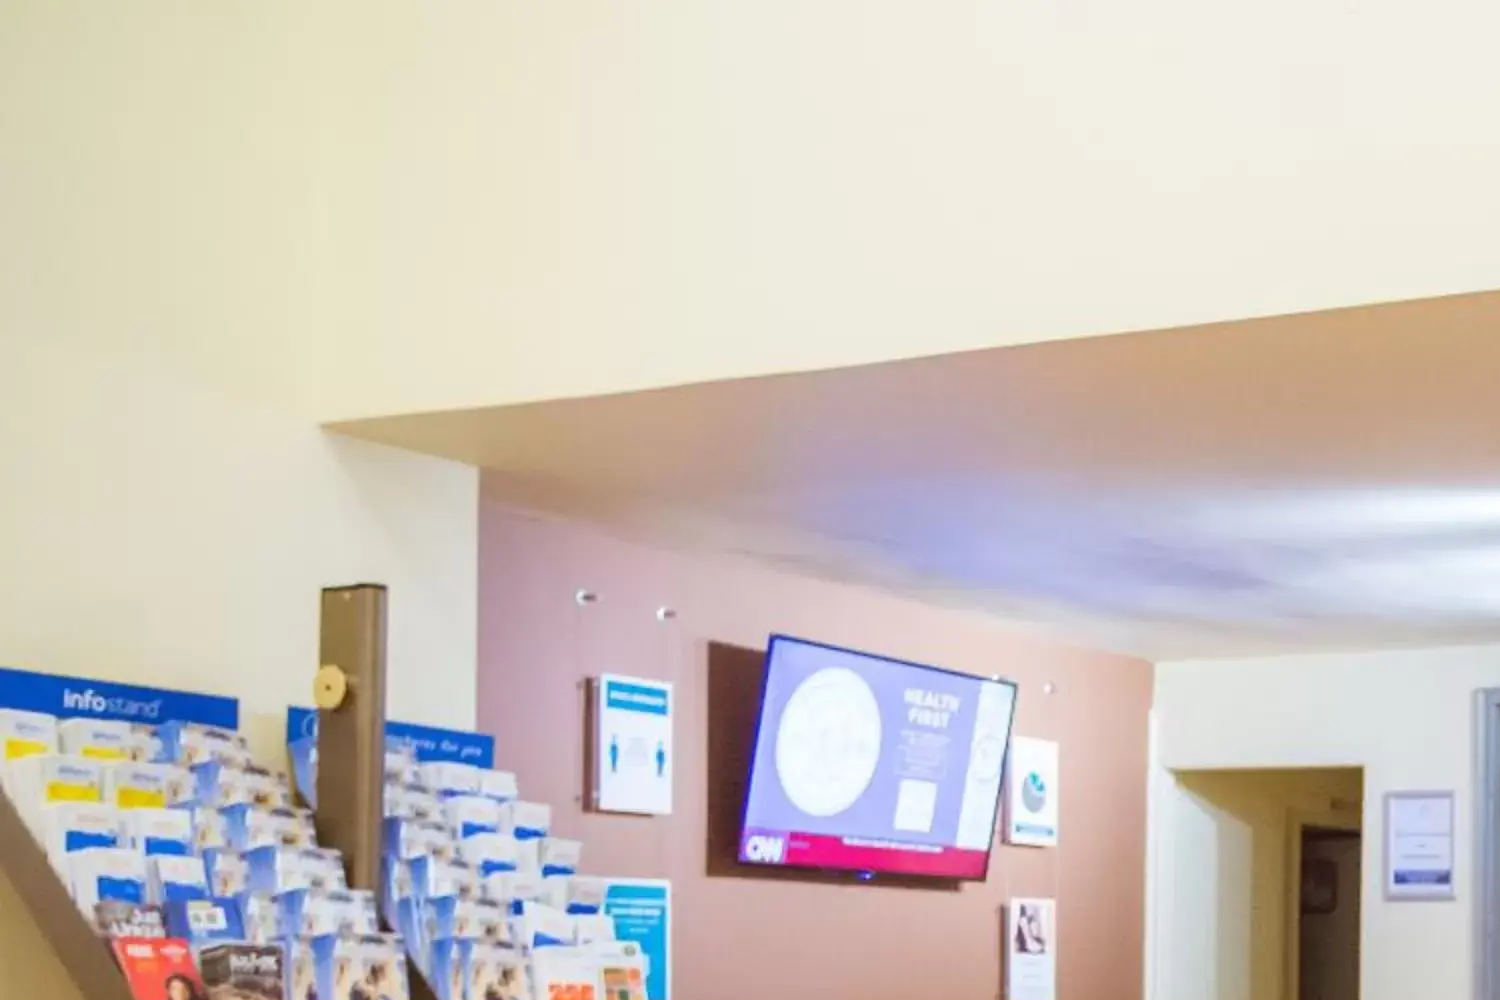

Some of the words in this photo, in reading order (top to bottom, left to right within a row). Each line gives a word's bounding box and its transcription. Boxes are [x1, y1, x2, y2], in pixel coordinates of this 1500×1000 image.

[63, 687, 161, 719] infostand
[903, 687, 961, 714] HEALTH
[907, 706, 950, 729] FIRST
